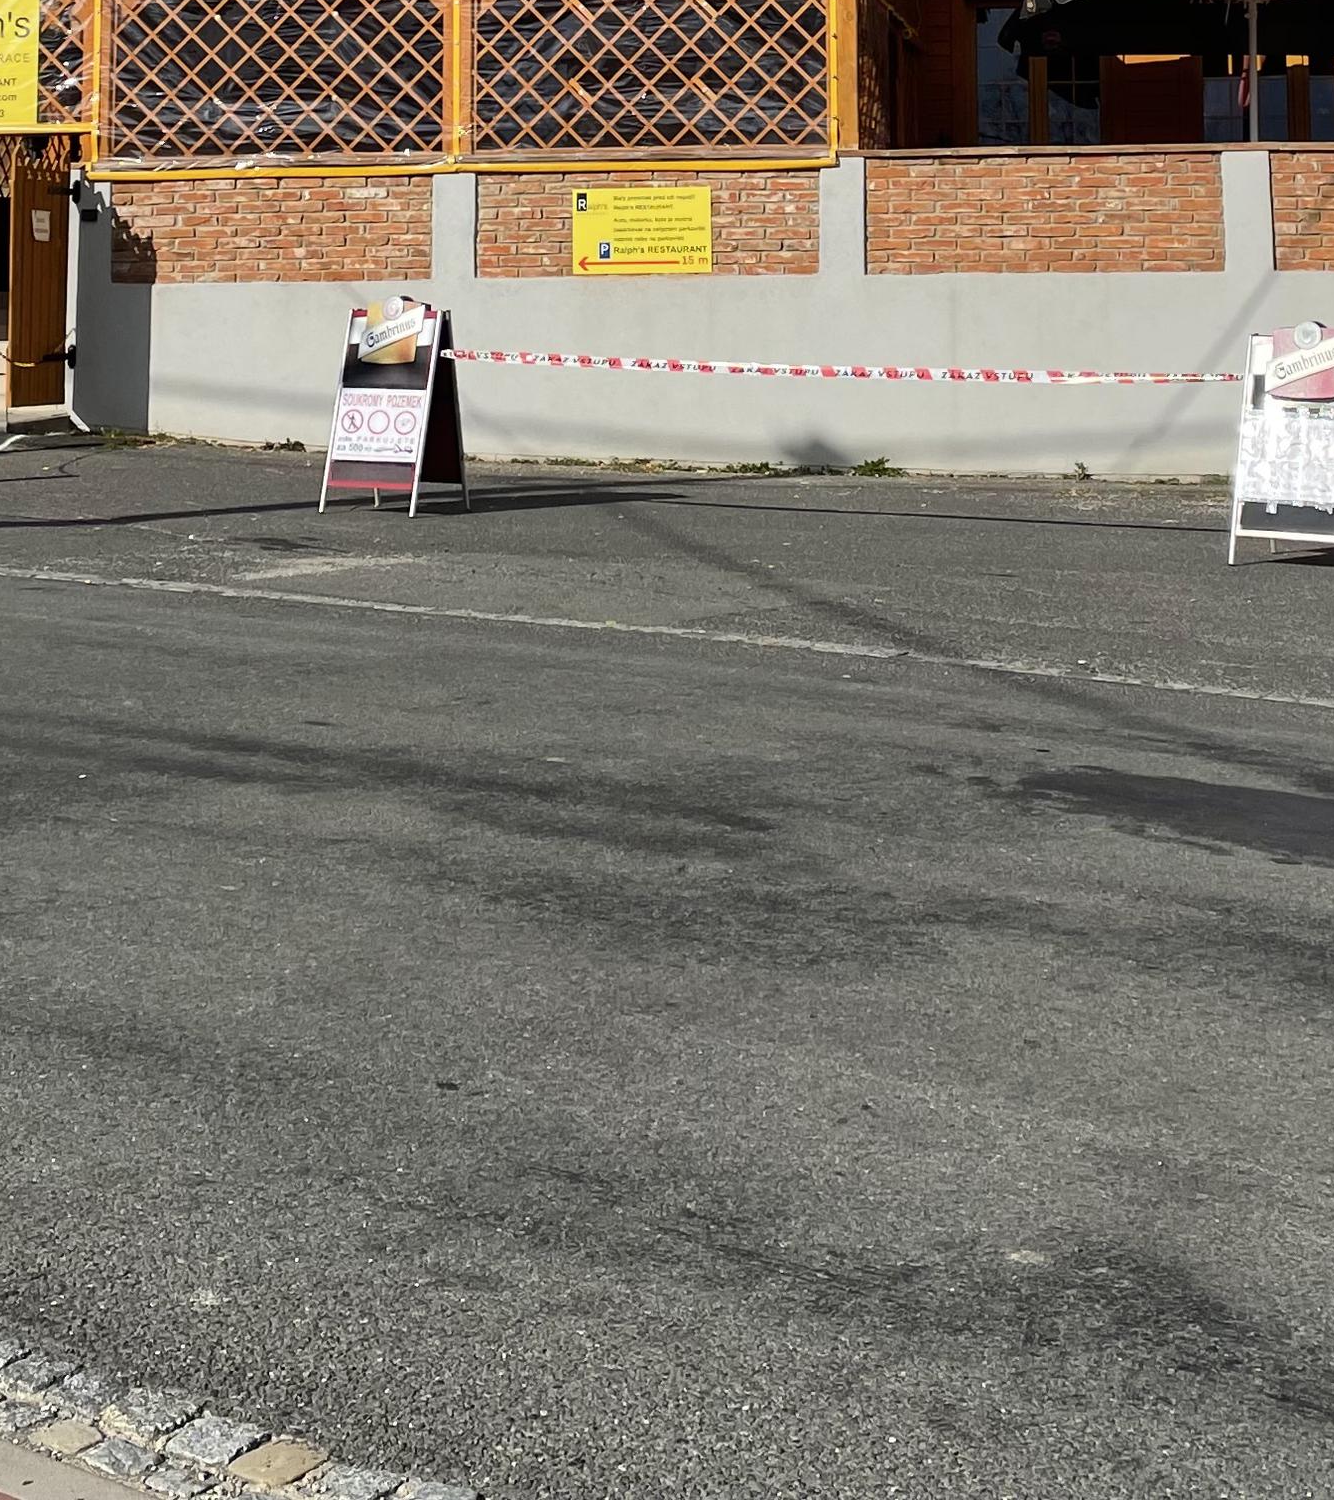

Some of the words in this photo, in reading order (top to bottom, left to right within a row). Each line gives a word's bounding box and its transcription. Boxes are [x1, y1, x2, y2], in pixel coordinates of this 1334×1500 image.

[613, 246, 645, 255] Ralph's
[647, 245, 707, 254] RESTAURANT
[682, 255, 695, 265] 15
[698, 256, 708, 265] m
[366, 317, 416, 348] Gambrinus
